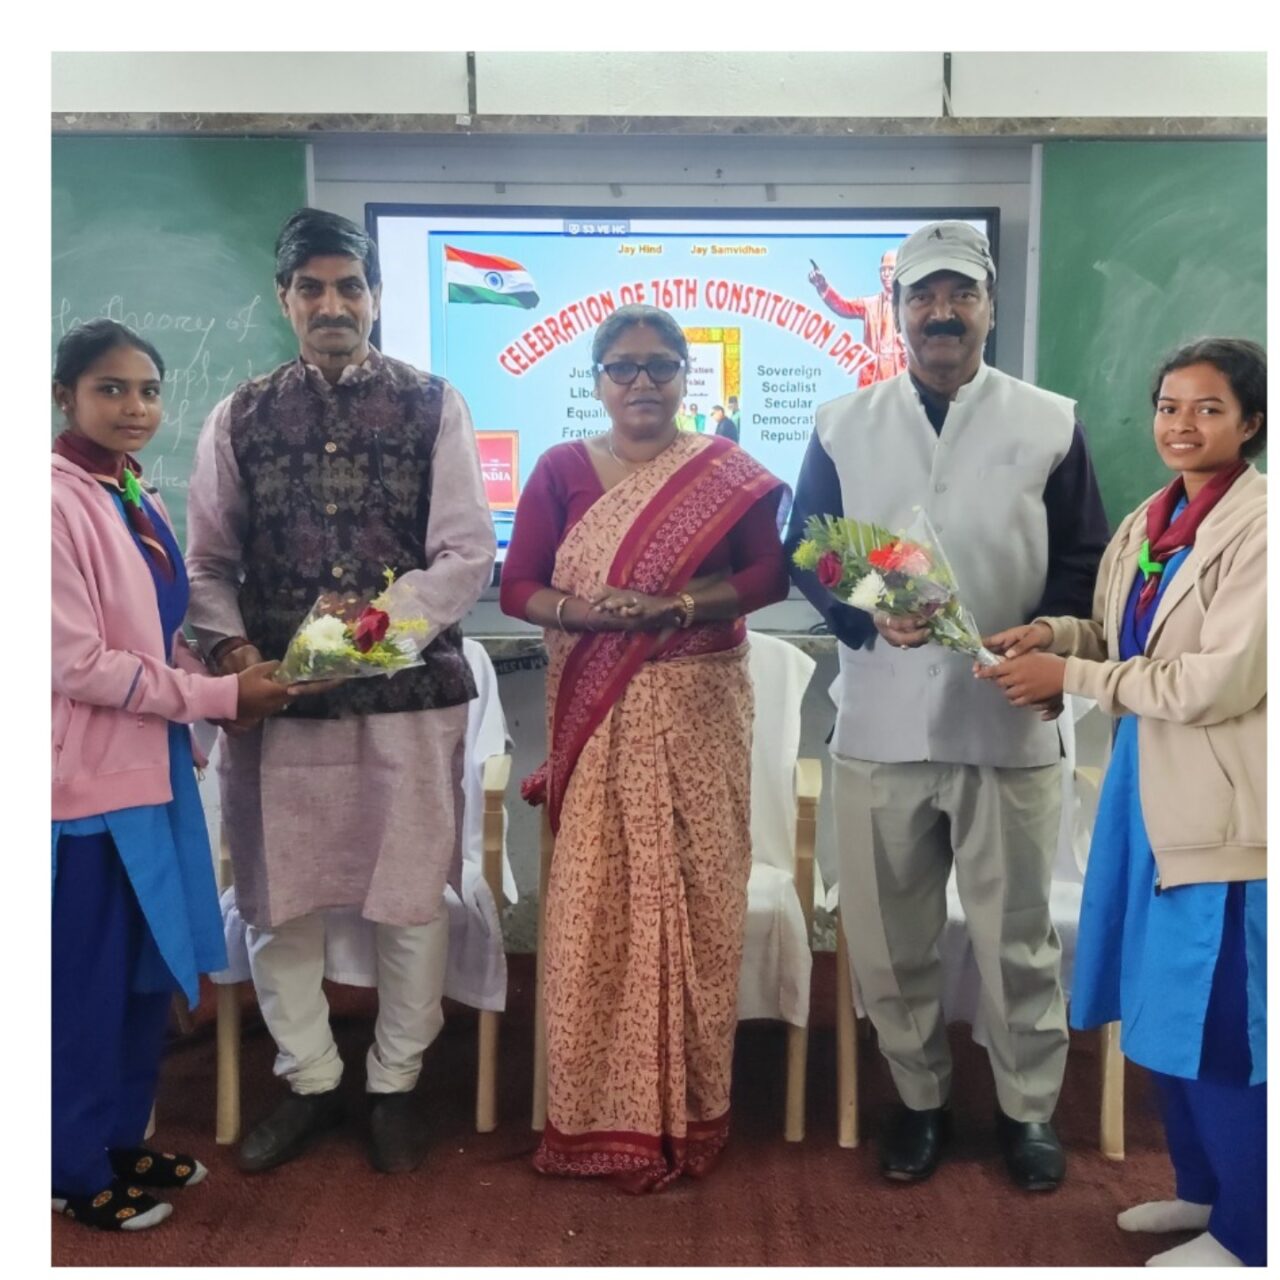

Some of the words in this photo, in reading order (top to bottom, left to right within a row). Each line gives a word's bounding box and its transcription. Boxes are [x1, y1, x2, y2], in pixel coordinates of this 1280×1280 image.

[618, 245, 635, 256] Jay
[638, 245, 662, 254] Hind
[691, 245, 708, 256] Jay
[711, 245, 767, 255] Samvidhan
[499, 290, 616, 374] CELEBRATION
[620, 282, 644, 305] OF
[705, 280, 835, 350] CONSTITUTION
[829, 331, 876, 375] DAY
[569, 367, 593, 378] Jus
[757, 365, 822, 379] Sovereign
[762, 381, 816, 393] Socialist
[764, 398, 812, 409] Secular
[567, 407, 607, 420] Equali
[752, 413, 815, 425] Democrat
[760, 429, 809, 444] Republi
[482, 471, 511, 481] NDIA
